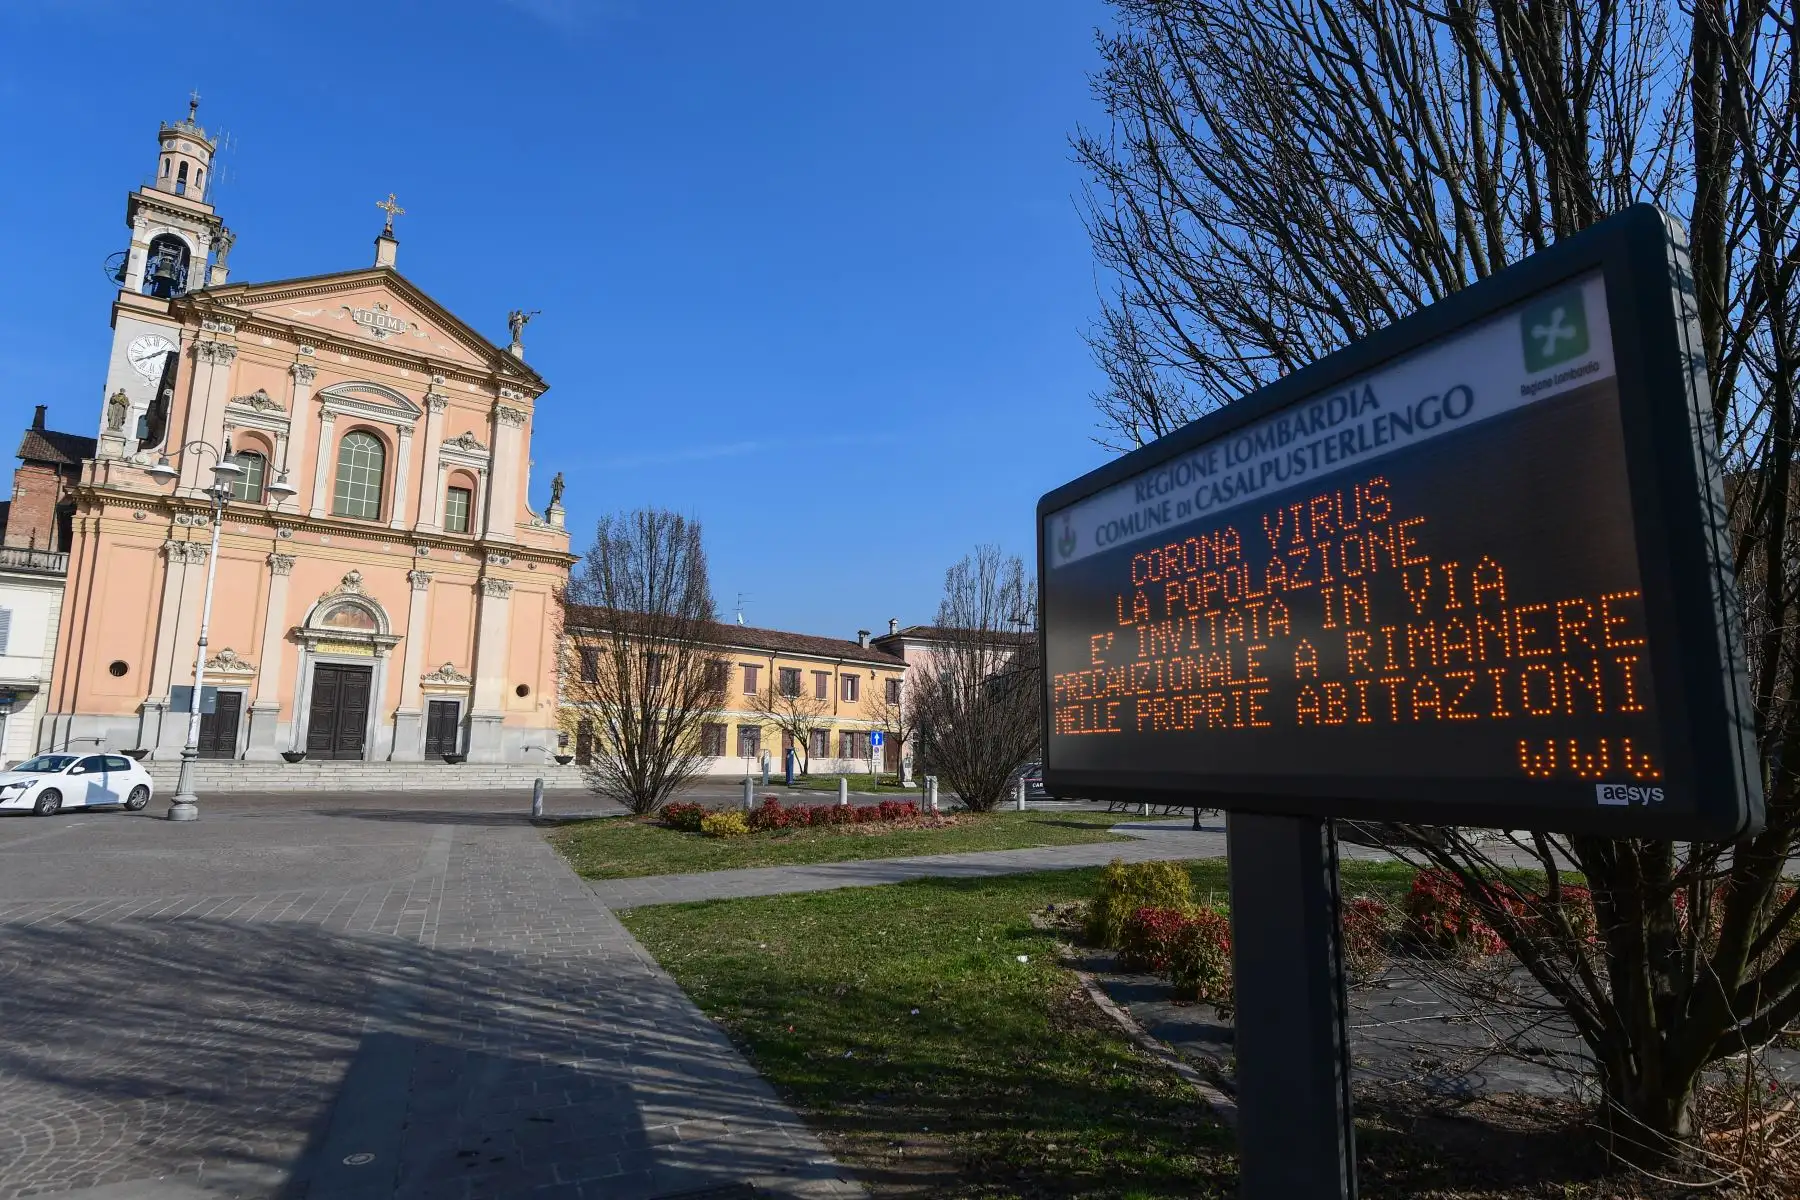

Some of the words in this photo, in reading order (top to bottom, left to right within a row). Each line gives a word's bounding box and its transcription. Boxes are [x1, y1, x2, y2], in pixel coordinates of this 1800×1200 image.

[1095, 499, 1172, 547] COMUNE
[1194, 384, 1474, 511] CASALPUSTERLENGO
[1133, 451, 1219, 504] REGIONE
[1224, 383, 1380, 469] LOMBARDIA
[1116, 589, 1149, 626] LA
[1165, 515, 1431, 616] POPOLAZIONE
[1132, 525, 1241, 586] CORONA
[1263, 476, 1392, 549] VIRUS
[1053, 644, 1270, 703] PRECAUZIONALE
[1294, 637, 1318, 679] A
[1346, 590, 1645, 674] RIMANERE
[1090, 631, 1114, 664] E'
[1137, 597, 1291, 657] INVITATA
[1320, 580, 1371, 629] IN
[1402, 554, 1506, 615] VIA
[1055, 701, 1121, 735] NELLE
[1136, 688, 1271, 732] PROPRIE
[1297, 655, 1645, 726] ABITAZIONI
[1603, 785, 1665, 806] aesys
